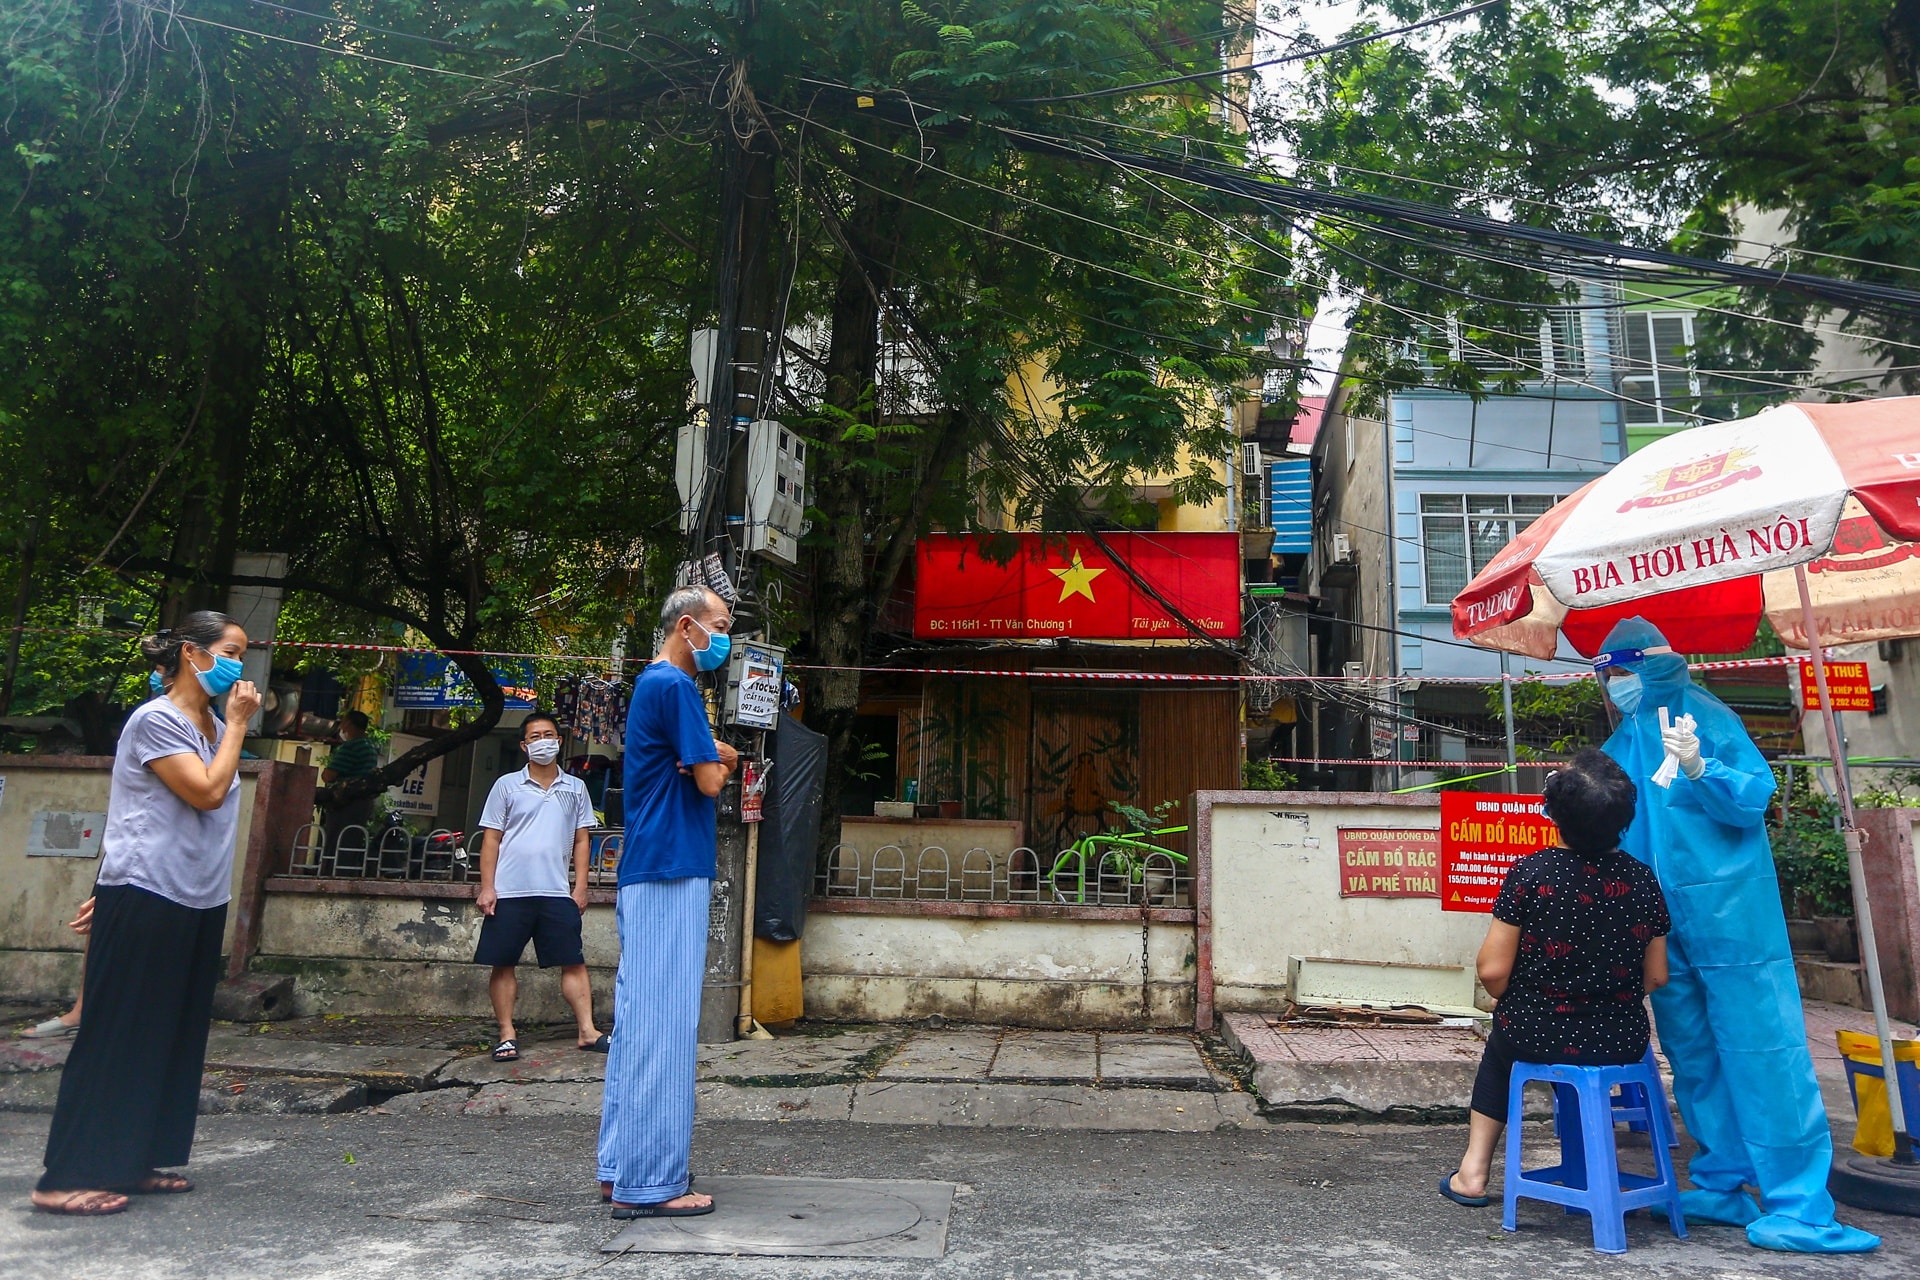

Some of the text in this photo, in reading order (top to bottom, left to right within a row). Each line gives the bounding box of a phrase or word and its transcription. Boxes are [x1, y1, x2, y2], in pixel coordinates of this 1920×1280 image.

[1651, 482, 1723, 505] HABECO
[1572, 513, 1813, 595] BIA HƠI HÀ NỘI
[930, 619, 949, 630] ĐC:
[951, 619, 980, 630] 116H1
[989, 619, 1003, 630] TT
[1005, 619, 1024, 630] Văn
[1026, 618, 1065, 632] Chương
[1067, 619, 1073, 630] 1
[1132, 617, 1149, 629] Tôi
[1197, 617, 1225, 630] Nam
[1805, 663, 1863, 678] CO THUÊ
[1833, 684, 1853, 695] KHÉP
[1854, 683, 1868, 695] KÍN
[741, 703, 752, 712] 097
[1836, 697, 1850, 706] 202
[1851, 698, 1870, 707] 4622
[402, 779, 425, 796] LEE
[1476, 801, 1500, 813] UBND
[1502, 801, 1526, 815] QUẬN
[1344, 831, 1368, 840] UBND
[1370, 830, 1395, 843] QUẬN
[1423, 832, 1436, 841] ĐA
[1450, 816, 1482, 843] CẤM
[1485, 816, 1505, 843] ĐỔ
[1508, 821, 1537, 846] RÁC
[1346, 845, 1437, 867] CẤM ĐỔ RÁC
[1460, 851, 1472, 862] Mọi
[1473, 851, 1488, 861] hành
[1450, 862, 1482, 873] 7.000.000
[1348, 871, 1437, 893] VÀ PHẾ THẢI
